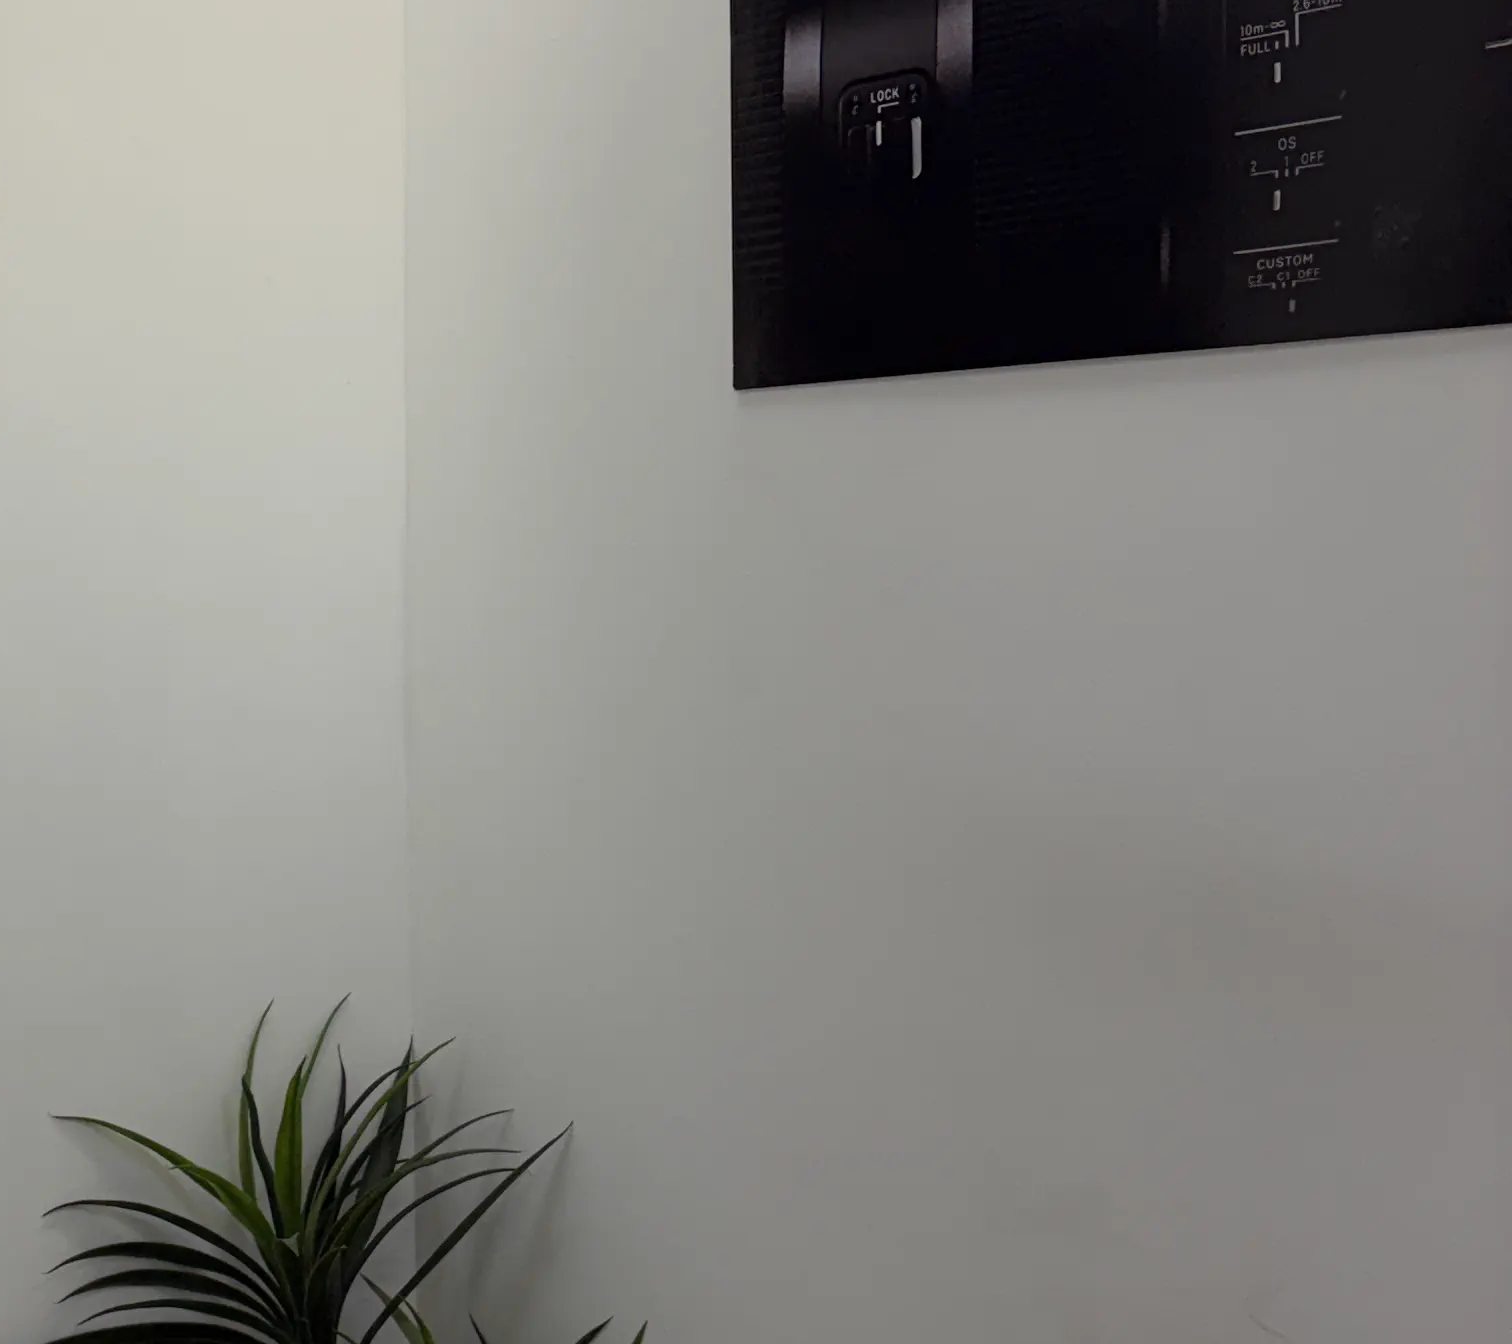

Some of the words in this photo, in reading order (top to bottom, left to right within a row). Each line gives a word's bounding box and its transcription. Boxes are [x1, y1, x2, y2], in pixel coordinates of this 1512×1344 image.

[1240, 40, 1271, 57] FULL
[869, 85, 900, 104] LOCK
[1277, 136, 1297, 152] OS
[1250, 160, 1258, 173] 2
[1300, 150, 1325, 165] OFF
[1256, 253, 1313, 271] CUSTOM
[1297, 268, 1321, 279] OFF
